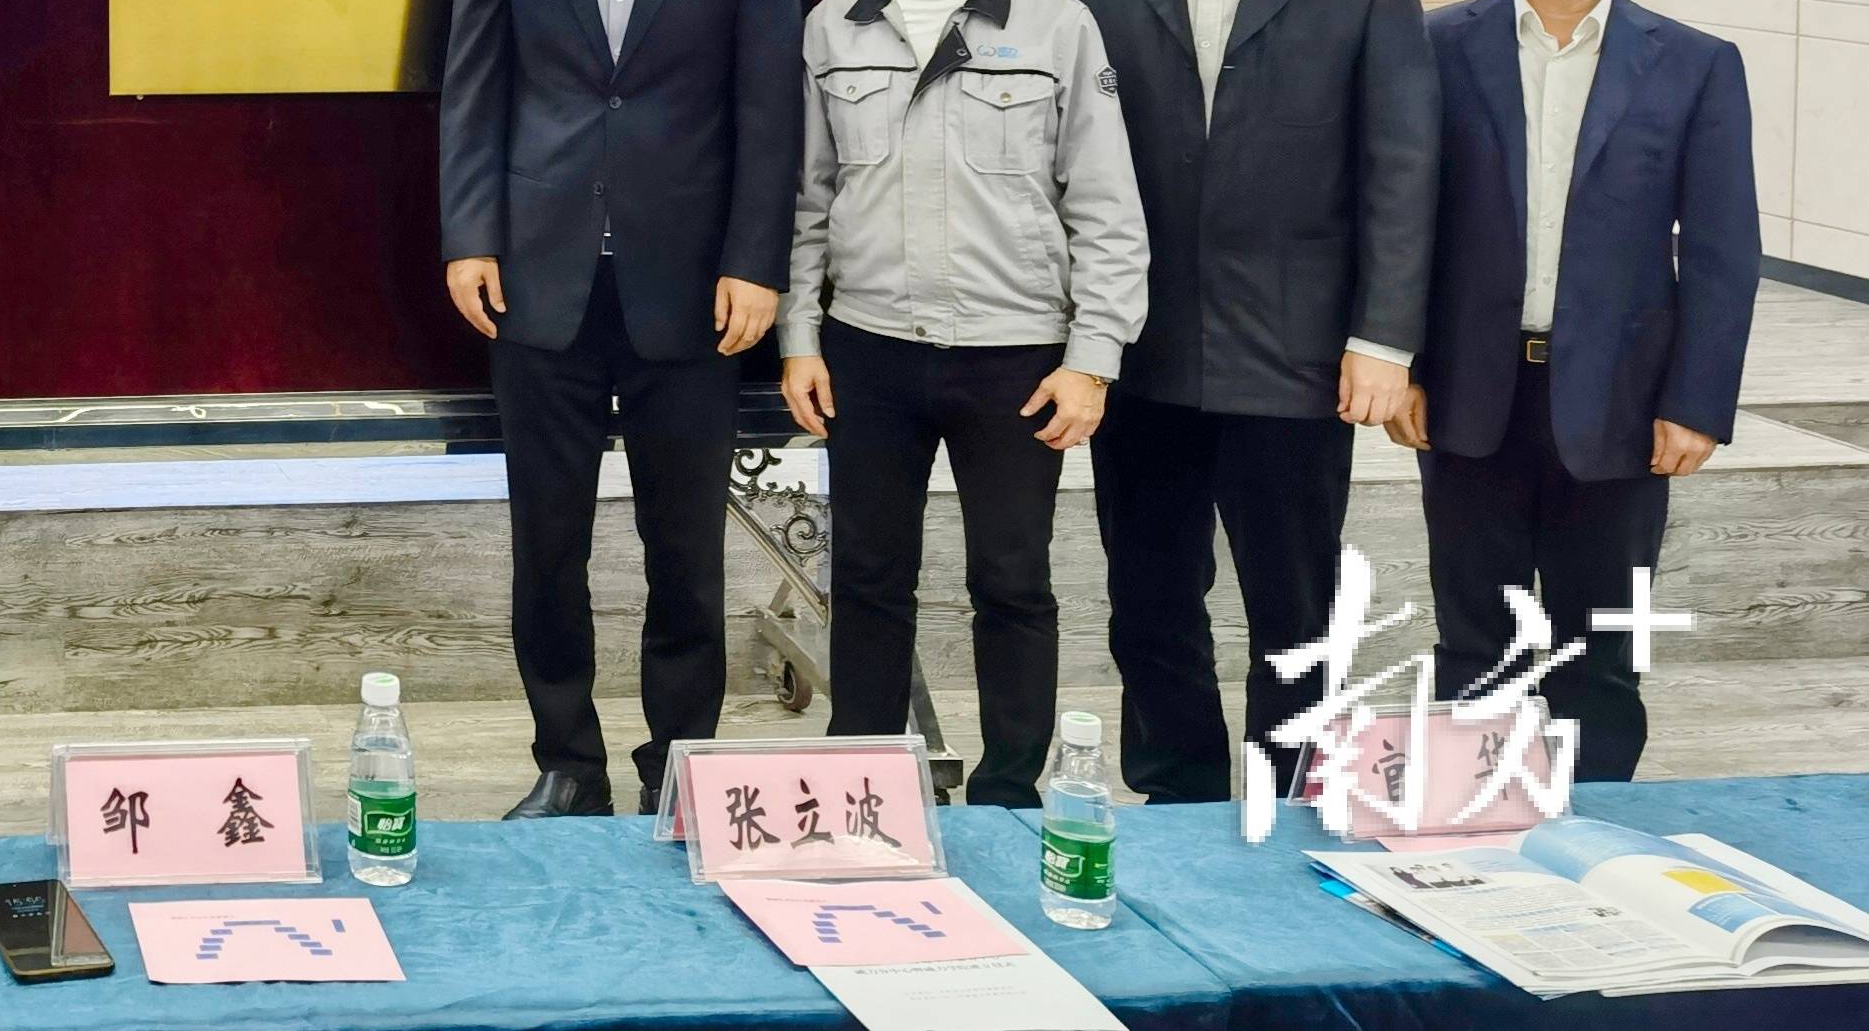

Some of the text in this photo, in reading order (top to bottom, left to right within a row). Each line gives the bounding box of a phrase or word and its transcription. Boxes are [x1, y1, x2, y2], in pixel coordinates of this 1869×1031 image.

[98, 776, 276, 854] 邹鑫
[725, 776, 903, 851] 张立波
